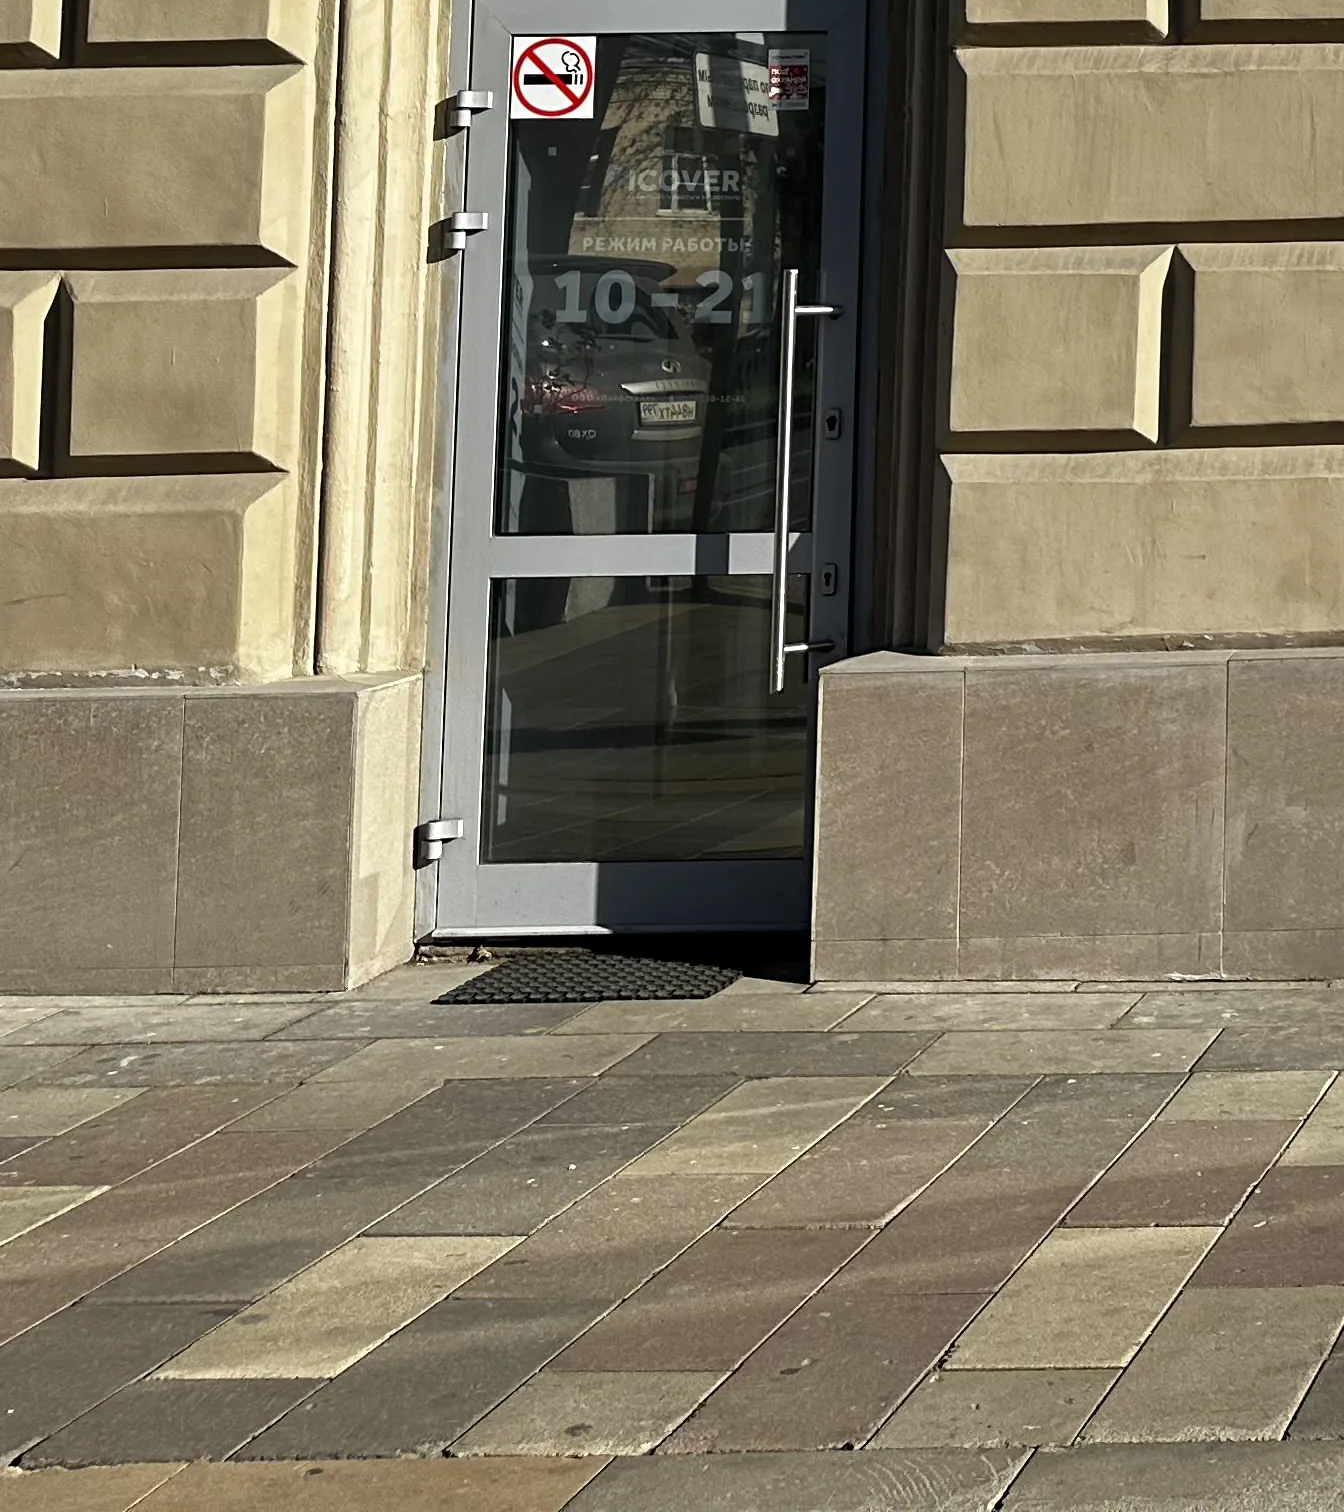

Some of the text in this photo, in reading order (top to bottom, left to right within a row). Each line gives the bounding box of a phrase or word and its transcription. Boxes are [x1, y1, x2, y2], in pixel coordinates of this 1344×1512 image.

[582, 237, 656, 252] РЕЖИМ
[554, 269, 636, 324] 10
[695, 270, 772, 324] 21
